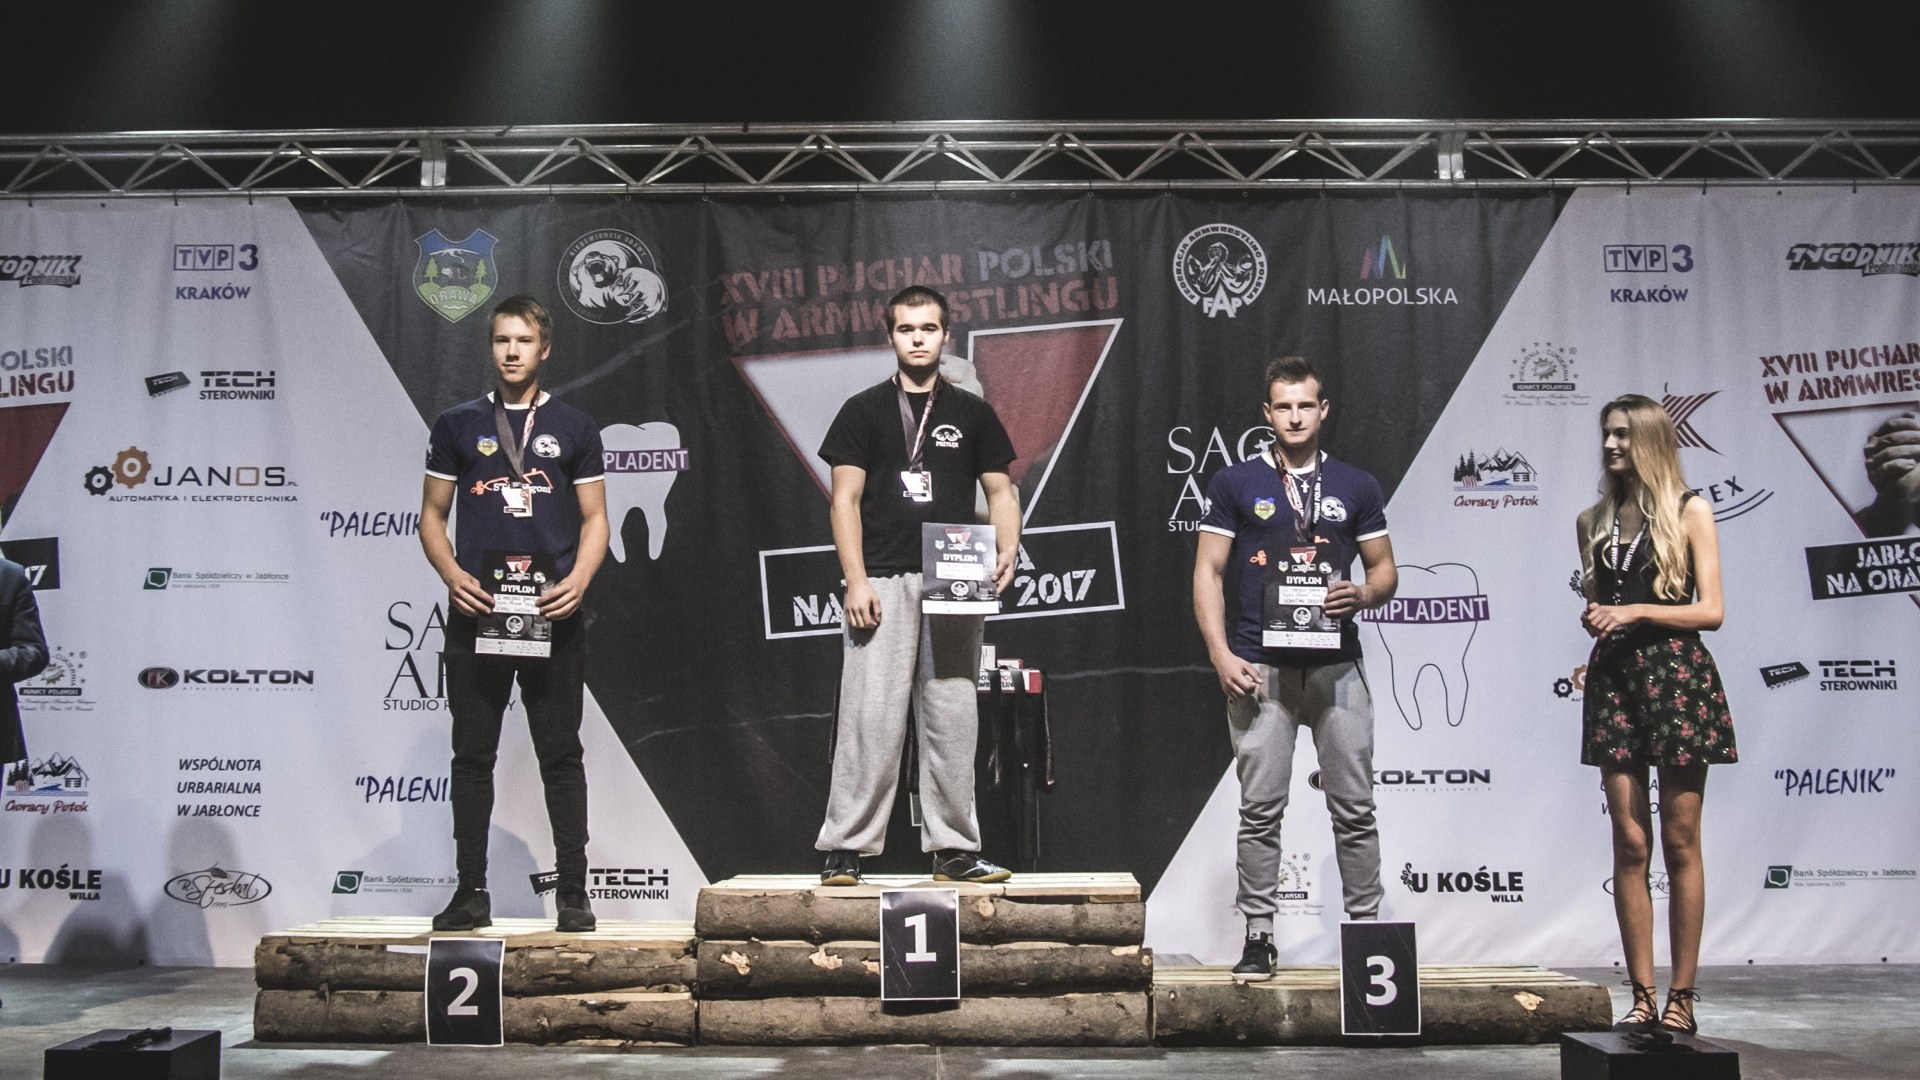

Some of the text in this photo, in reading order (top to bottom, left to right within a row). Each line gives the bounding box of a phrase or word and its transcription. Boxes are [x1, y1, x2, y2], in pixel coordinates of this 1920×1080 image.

[177, 244, 258, 270] TVP 3
[1188, 225, 1262, 258] ARMWRESTLING
[1247, 261, 1265, 300] POLSKA
[1607, 245, 1694, 272] TVP 3
[1786, 245, 1920, 267] TYGODNIK
[0, 257, 82, 279] ODNIK
[721, 239, 1113, 304] XVIII PUCHAR POLSKI
[175, 283, 251, 300] KRAKÓW
[430, 289, 478, 305] ORAWA
[1203, 283, 1242, 318] FAP
[1307, 287, 1458, 305] MAŁOPOLSKA
[1610, 284, 1689, 302] KRAKÓW
[722, 276, 1118, 344] W ARMWSTLINGU
[0, 345, 73, 371] OLSKI
[1759, 342, 1920, 378] XVIII PUCHAR
[0, 370, 75, 399] LINGU
[200, 370, 275, 388] TECH
[1763, 368, 1920, 404] W ARMWRES
[199, 389, 275, 400] STEROWNIKI
[604, 450, 688, 471] PLADENT
[1502, 495, 1539, 509] Potok
[1168, 520, 1201, 532] STU
[942, 553, 978, 563] DYPLOM
[1856, 542, 1920, 568] JABŁO
[24, 564, 48, 586] 17
[1286, 576, 1322, 585] DYPLOM
[1826, 566, 1920, 595] NA ORA
[501, 584, 536, 594] DYPLOM
[1013, 569, 1097, 607] 2017
[385, 601, 447, 651] SA
[183, 669, 314, 685] KOŁTON
[1768, 665, 1797, 677] TECH
[1818, 660, 1896, 678] TECH
[1820, 680, 1897, 691] STEROWNIKI
[383, 699, 440, 711] STUDIO
[178, 757, 262, 772] WSPÓLNOTA
[1373, 769, 1491, 785] OŁTON
[177, 782, 262, 794] URBARIALNA
[355, 776, 451, 804] “PALENI
[53, 799, 89, 815] Potok
[177, 804, 261, 818] W JABŁONCE
[19, 863, 103, 890] KOŚLE
[363, 875, 384, 883] Bank
[538, 873, 560, 883] TEC
[589, 868, 669, 886] TECH
[1412, 865, 1524, 893] U KOŚLE
[1881, 869, 1917, 877] Jabłonce
[69, 891, 100, 901] WILLA
[589, 888, 669, 899] STEROWNIKI
[1491, 894, 1524, 903] WILLA
[904, 913, 938, 963] 1
[1365, 955, 1398, 1006] 3
[446, 967, 480, 1016] 2
